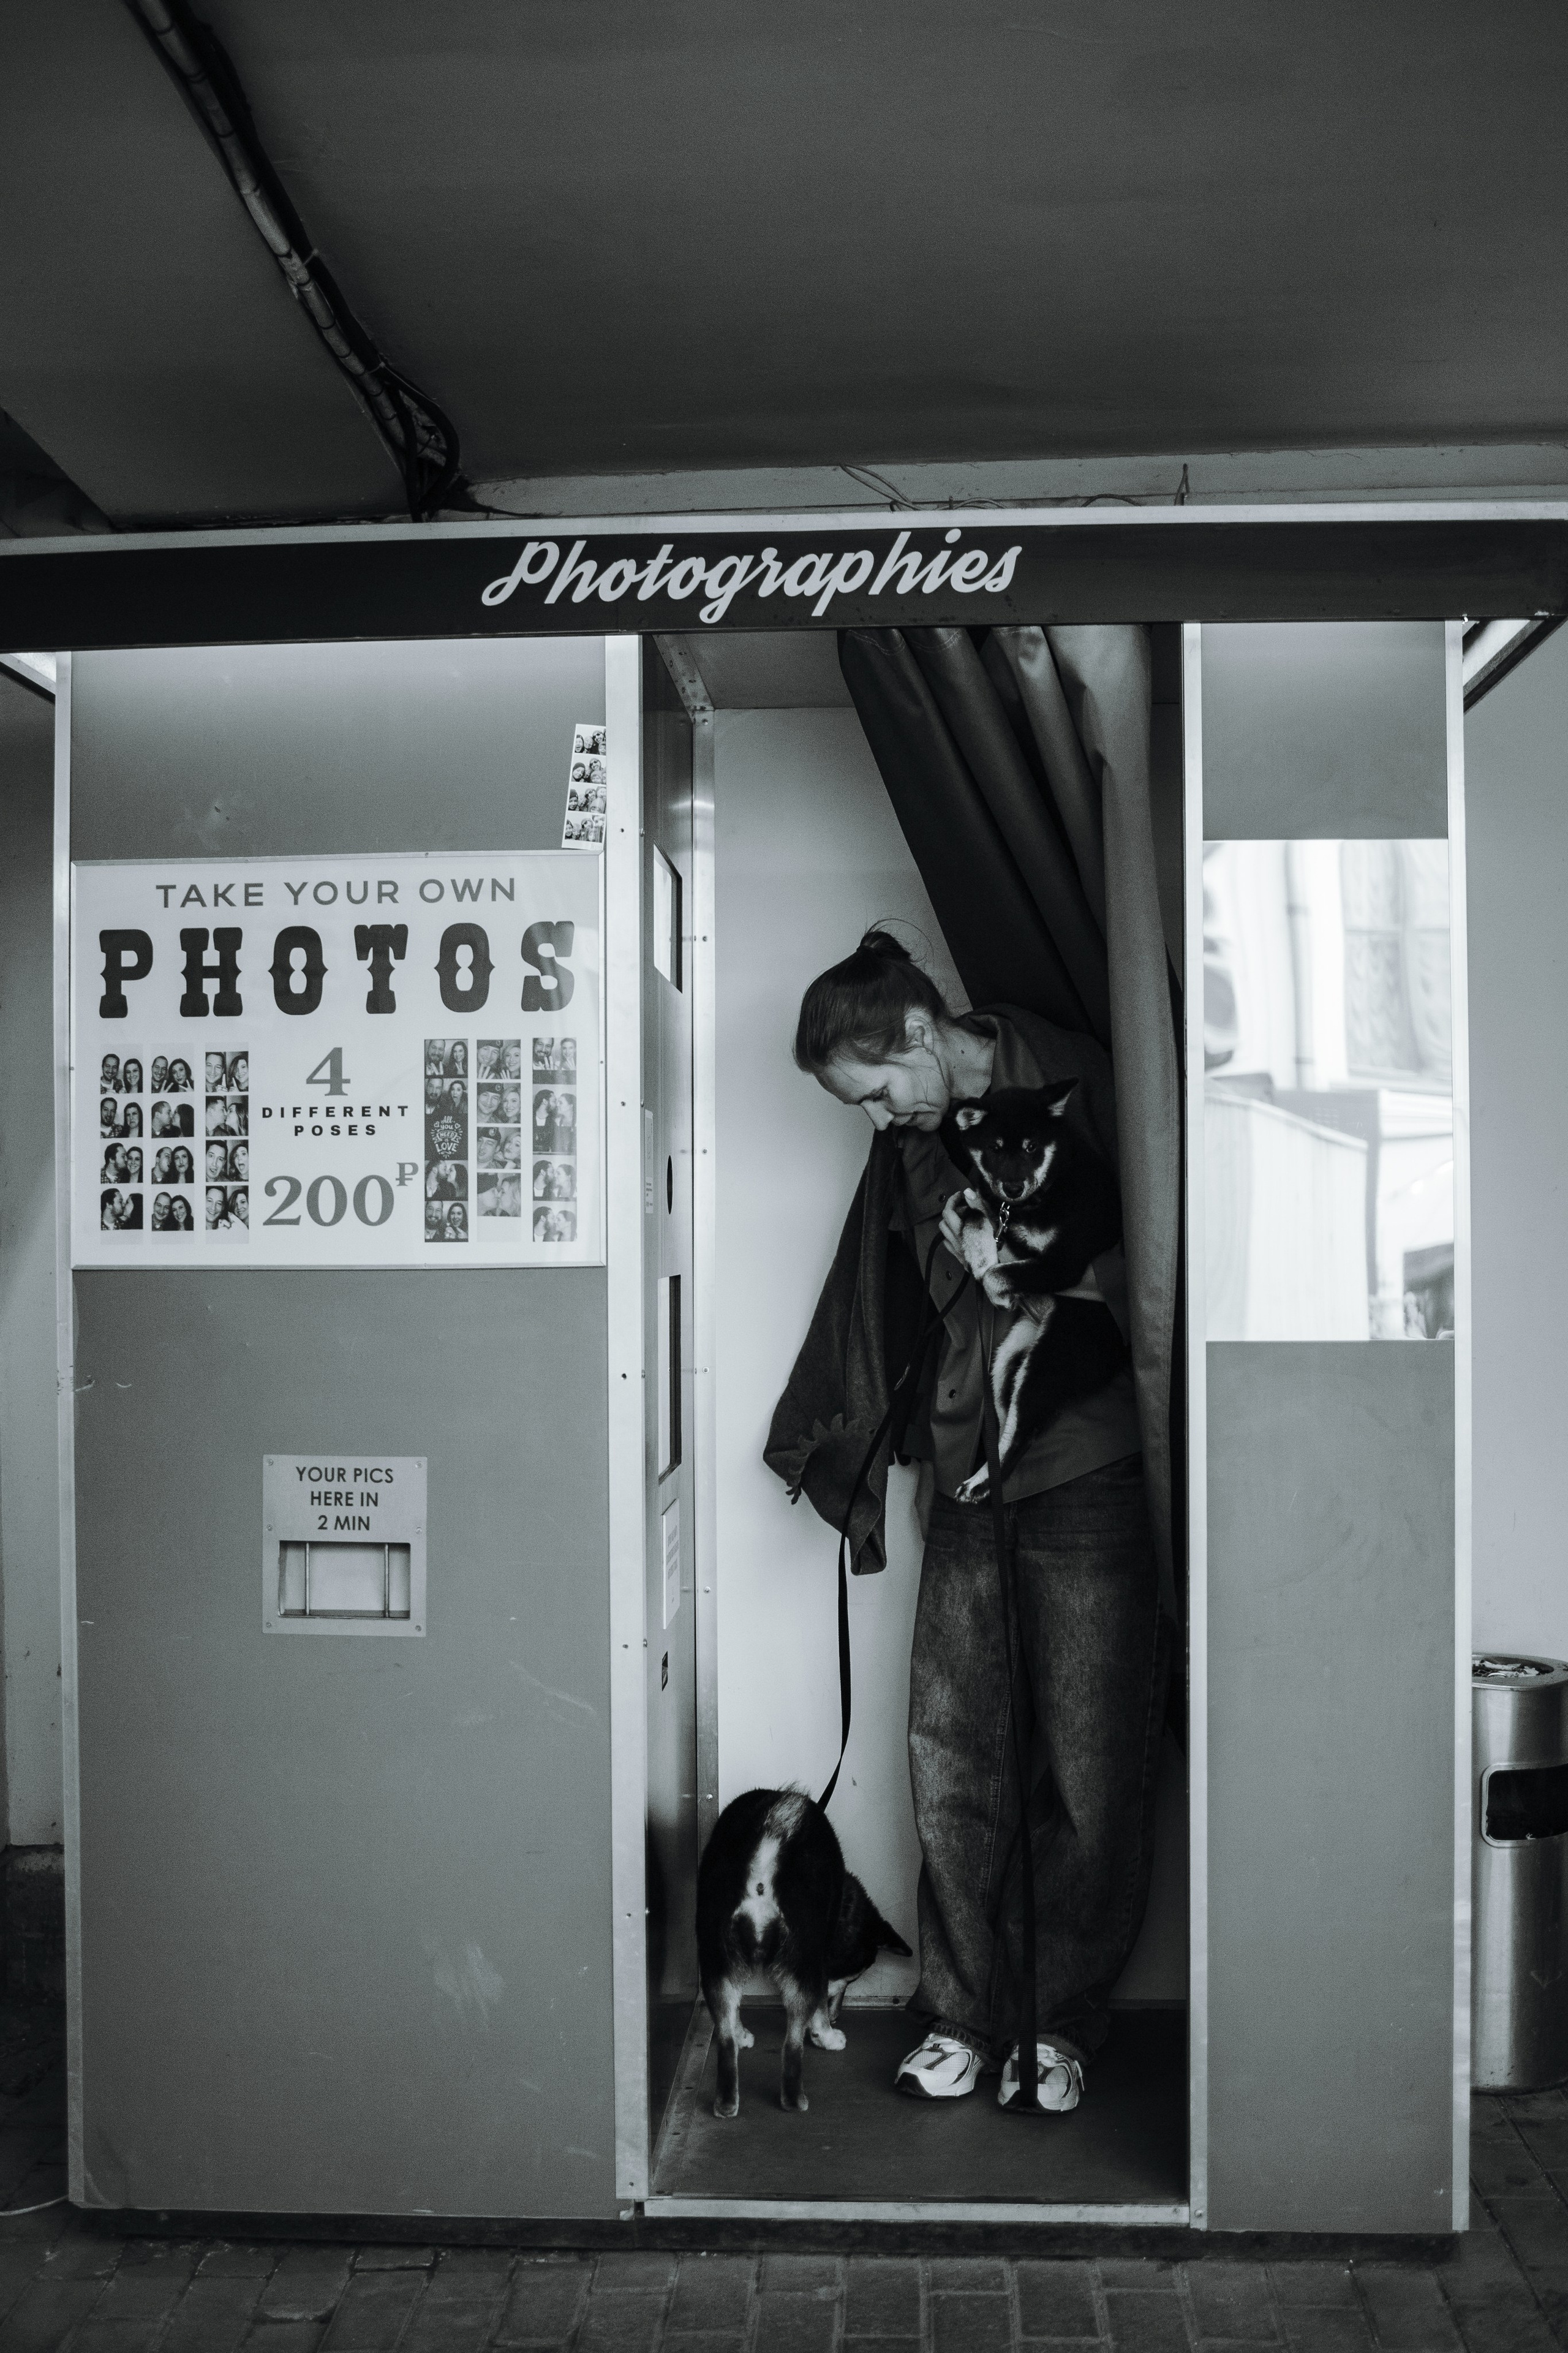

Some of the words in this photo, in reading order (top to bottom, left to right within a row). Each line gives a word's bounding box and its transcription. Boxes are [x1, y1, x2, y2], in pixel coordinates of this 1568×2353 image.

[482, 528, 1022, 624] Photographies
[156, 883, 264, 908] TAKE
[284, 880, 399, 906] YOUR
[418, 877, 515, 904] OWN
[99, 921, 575, 1019] PHOTOS
[306, 1047, 351, 1097] 4
[262, 1105, 408, 1119] DIFFERENT
[294, 1124, 375, 1137] POSES
[435, 1143, 459, 1152] LOVE
[296, 1466, 347, 1482] YOUR
[353, 1467, 394, 1484] PICS
[311, 1490, 353, 1507] HERE
[360, 1492, 379, 1507] IN
[317, 1514, 328, 1530] 2
[334, 1515, 370, 1531] MIN
